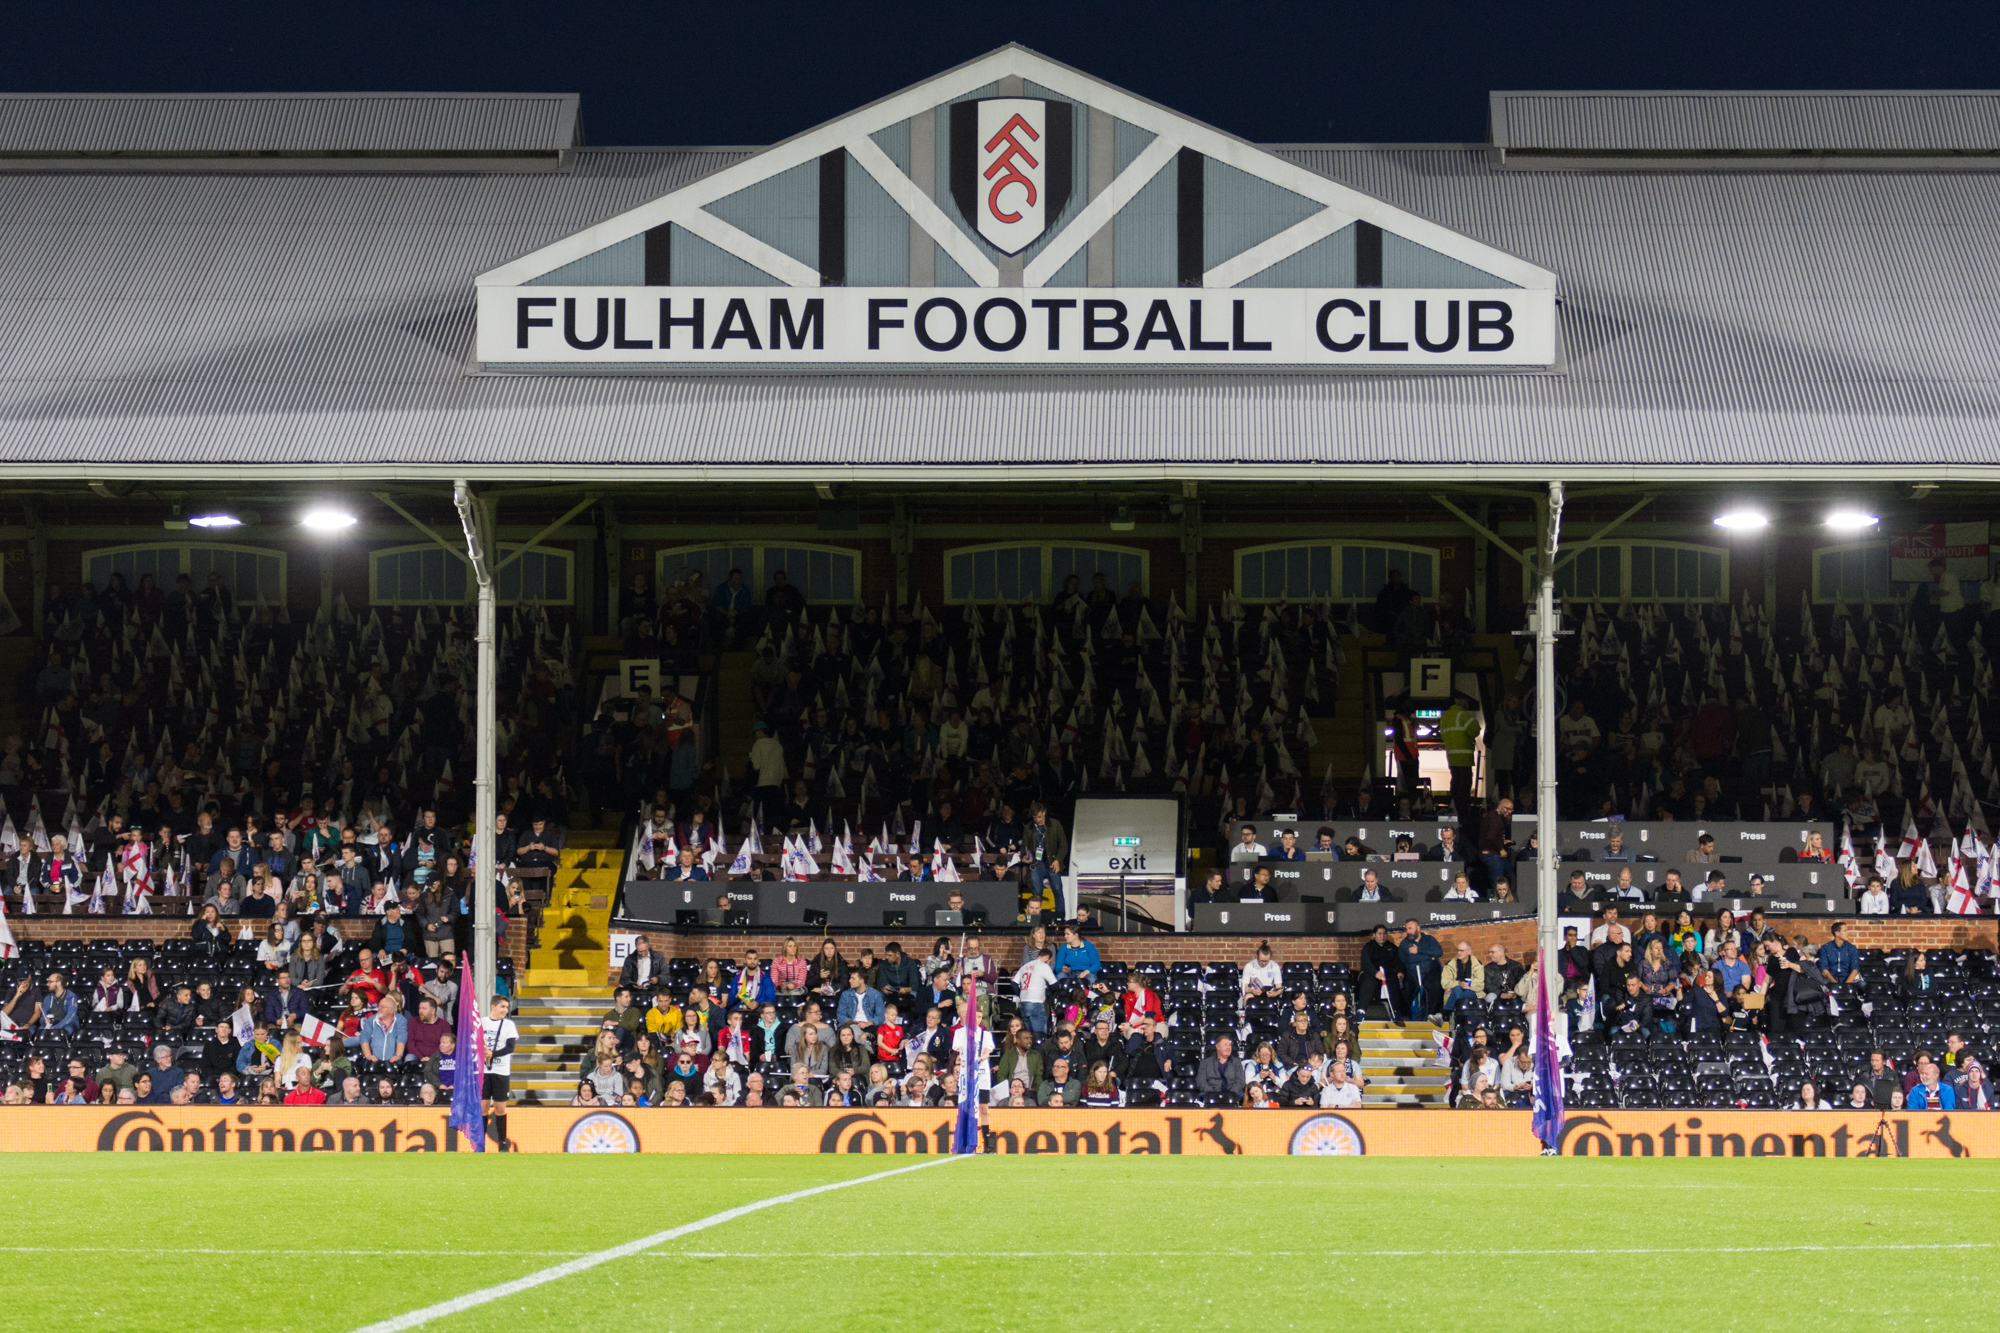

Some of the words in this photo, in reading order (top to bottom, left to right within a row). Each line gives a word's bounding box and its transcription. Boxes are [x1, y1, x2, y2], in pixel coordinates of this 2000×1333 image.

[516, 298, 823, 350] FULHAM
[867, 298, 1271, 351] FOOTBALL
[1315, 299, 1514, 351] CLUB
[1904, 546, 1975, 558] PORTSMOUTH
[629, 665, 650, 692] E
[1421, 664, 1441, 691] F
[1273, 829, 1299, 838] Prs
[1579, 830, 1606, 839] Press
[1740, 831, 1767, 840] Press
[1108, 853, 1147, 870] exit
[1274, 869, 1301, 879] Press
[1391, 869, 1418, 879] Press
[1585, 871, 1611, 881] Press
[727, 892, 754, 901] Press
[889, 892, 917, 902] Press
[1770, 900, 1798, 910] Press
[1264, 912, 1292, 922] Press
[1430, 912, 1457, 922] Press
[96, 1109, 458, 1152] Continental
[820, 1111, 1182, 1154] Contnental
[1557, 1114, 1910, 1157] Continental
